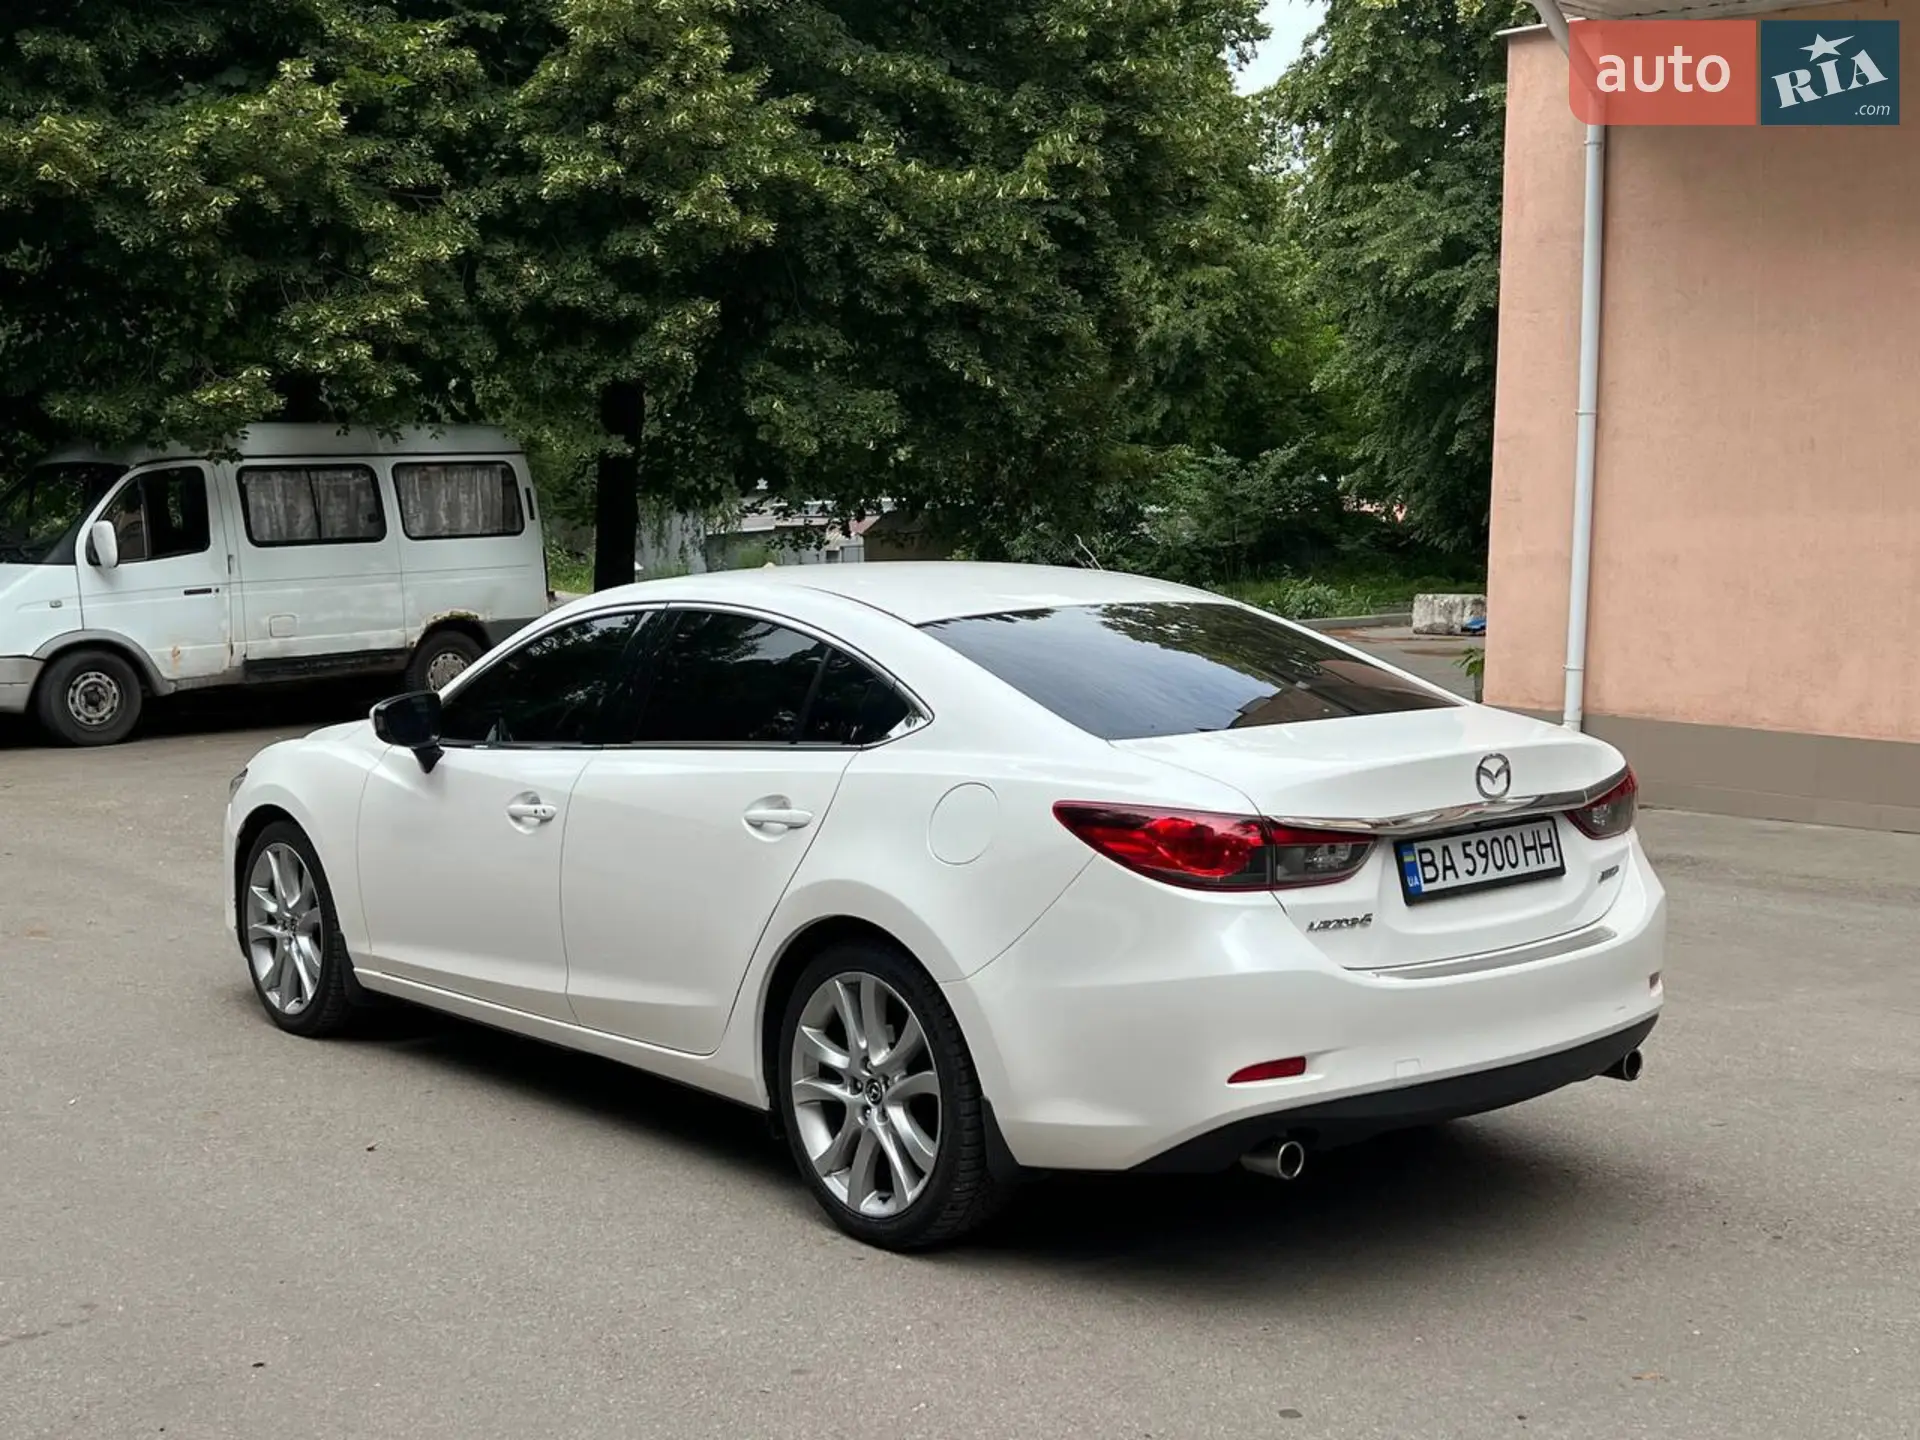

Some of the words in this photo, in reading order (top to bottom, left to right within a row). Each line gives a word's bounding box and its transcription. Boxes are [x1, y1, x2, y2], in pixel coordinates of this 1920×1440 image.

[1418, 845, 1460, 885] BA
[1463, 835, 1519, 876] 5900
[1520, 828, 1557, 866] HH
[1406, 876, 1420, 887] UA
